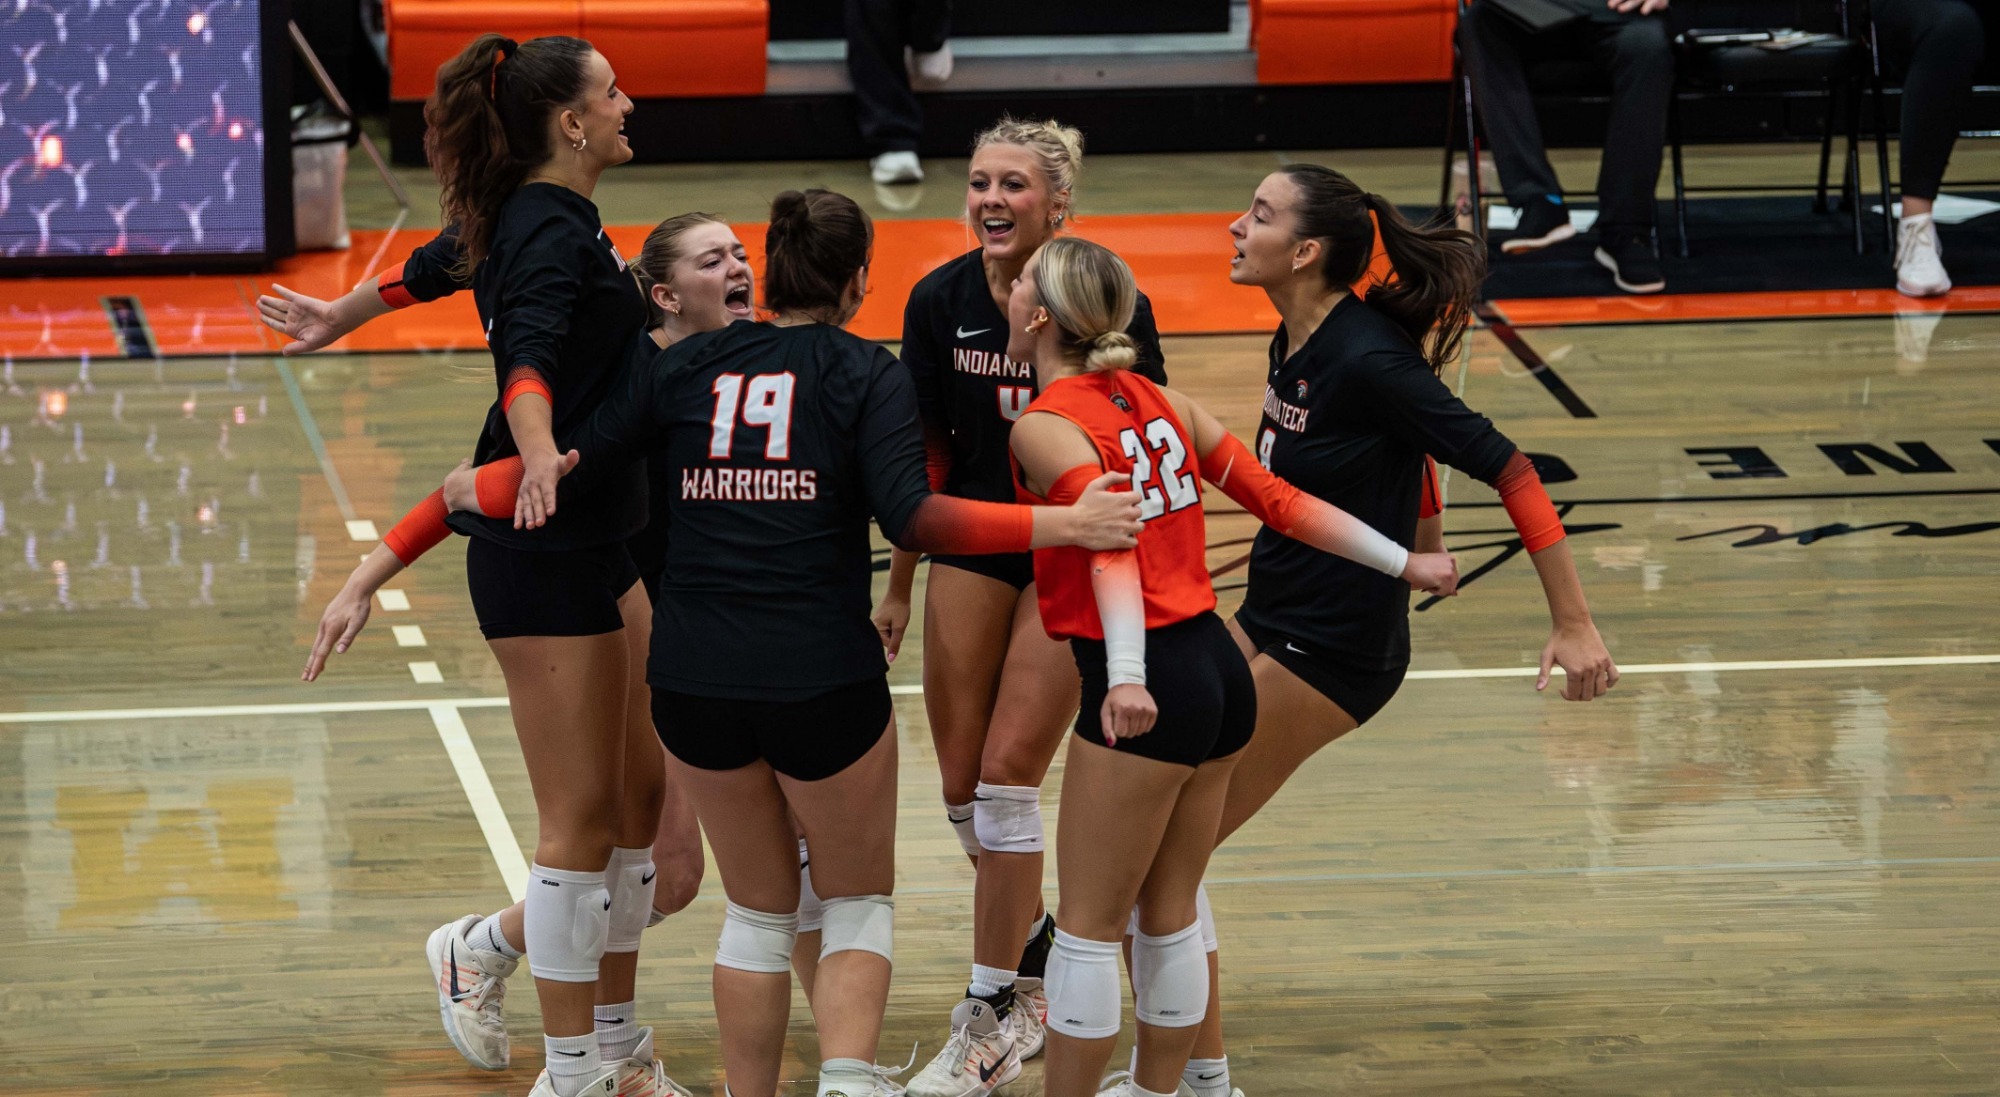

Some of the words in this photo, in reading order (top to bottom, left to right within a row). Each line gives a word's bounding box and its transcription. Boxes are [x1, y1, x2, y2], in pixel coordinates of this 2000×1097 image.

[953, 346, 1031, 379] INDIANA
[708, 371, 797, 461] 19
[1280, 402, 1309, 433] TECH
[681, 467, 817, 502] WARRIORS
[1118, 416, 1201, 523] 22
